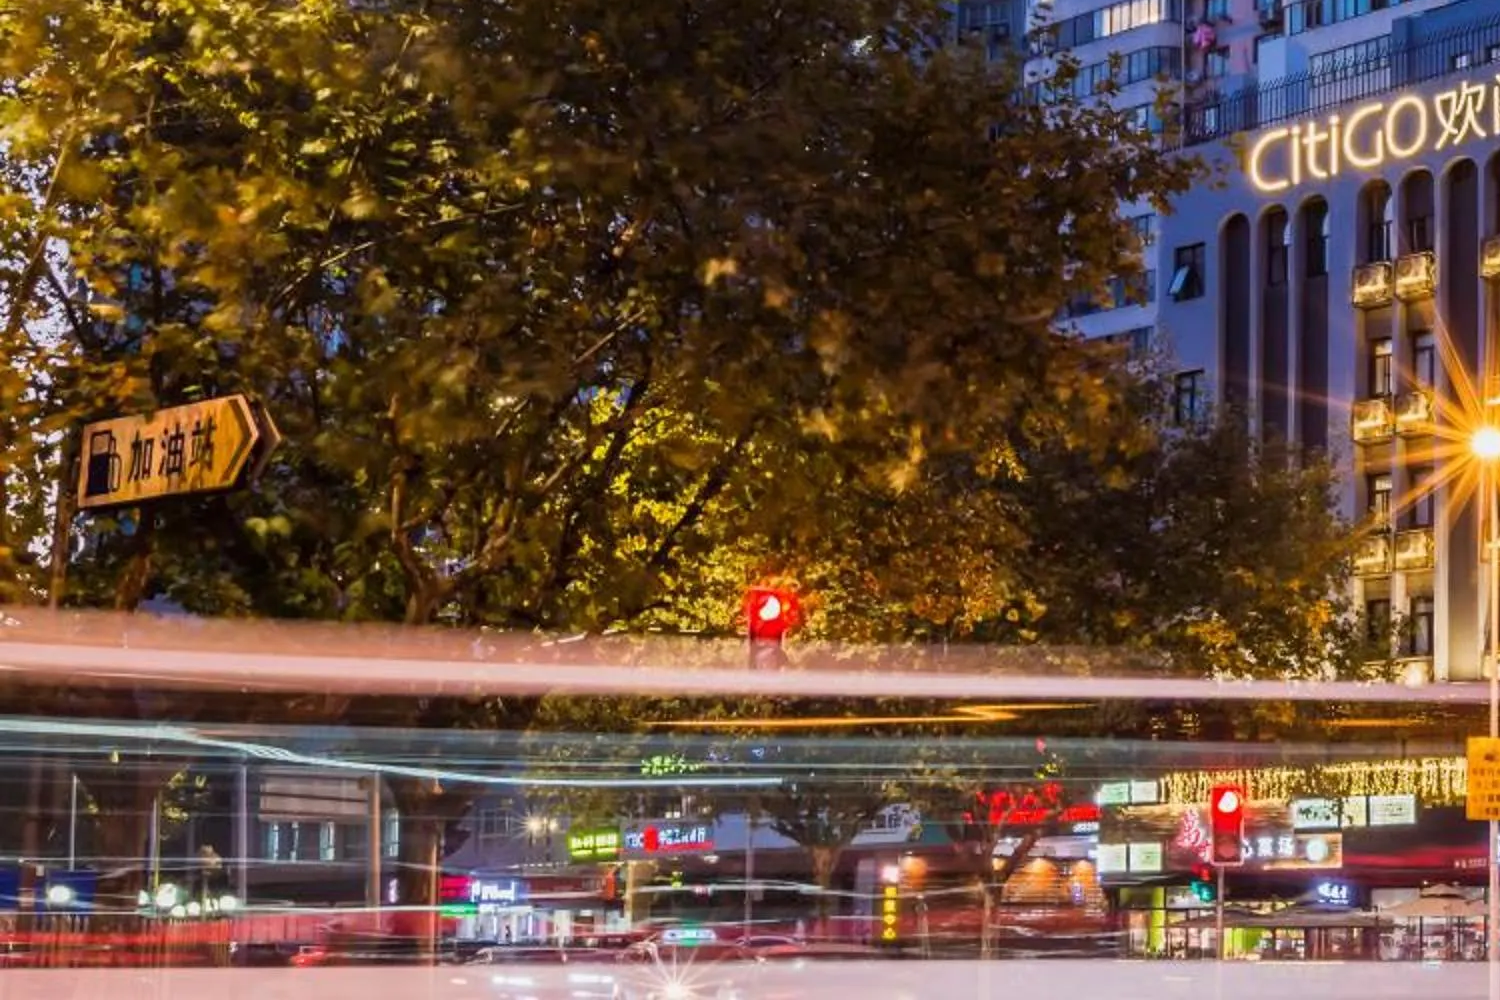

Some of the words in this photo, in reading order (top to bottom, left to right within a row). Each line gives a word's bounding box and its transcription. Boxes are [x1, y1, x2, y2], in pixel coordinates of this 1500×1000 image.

[1250, 96, 1427, 191] CitiGO
[128, 416, 217, 483] 加油站
